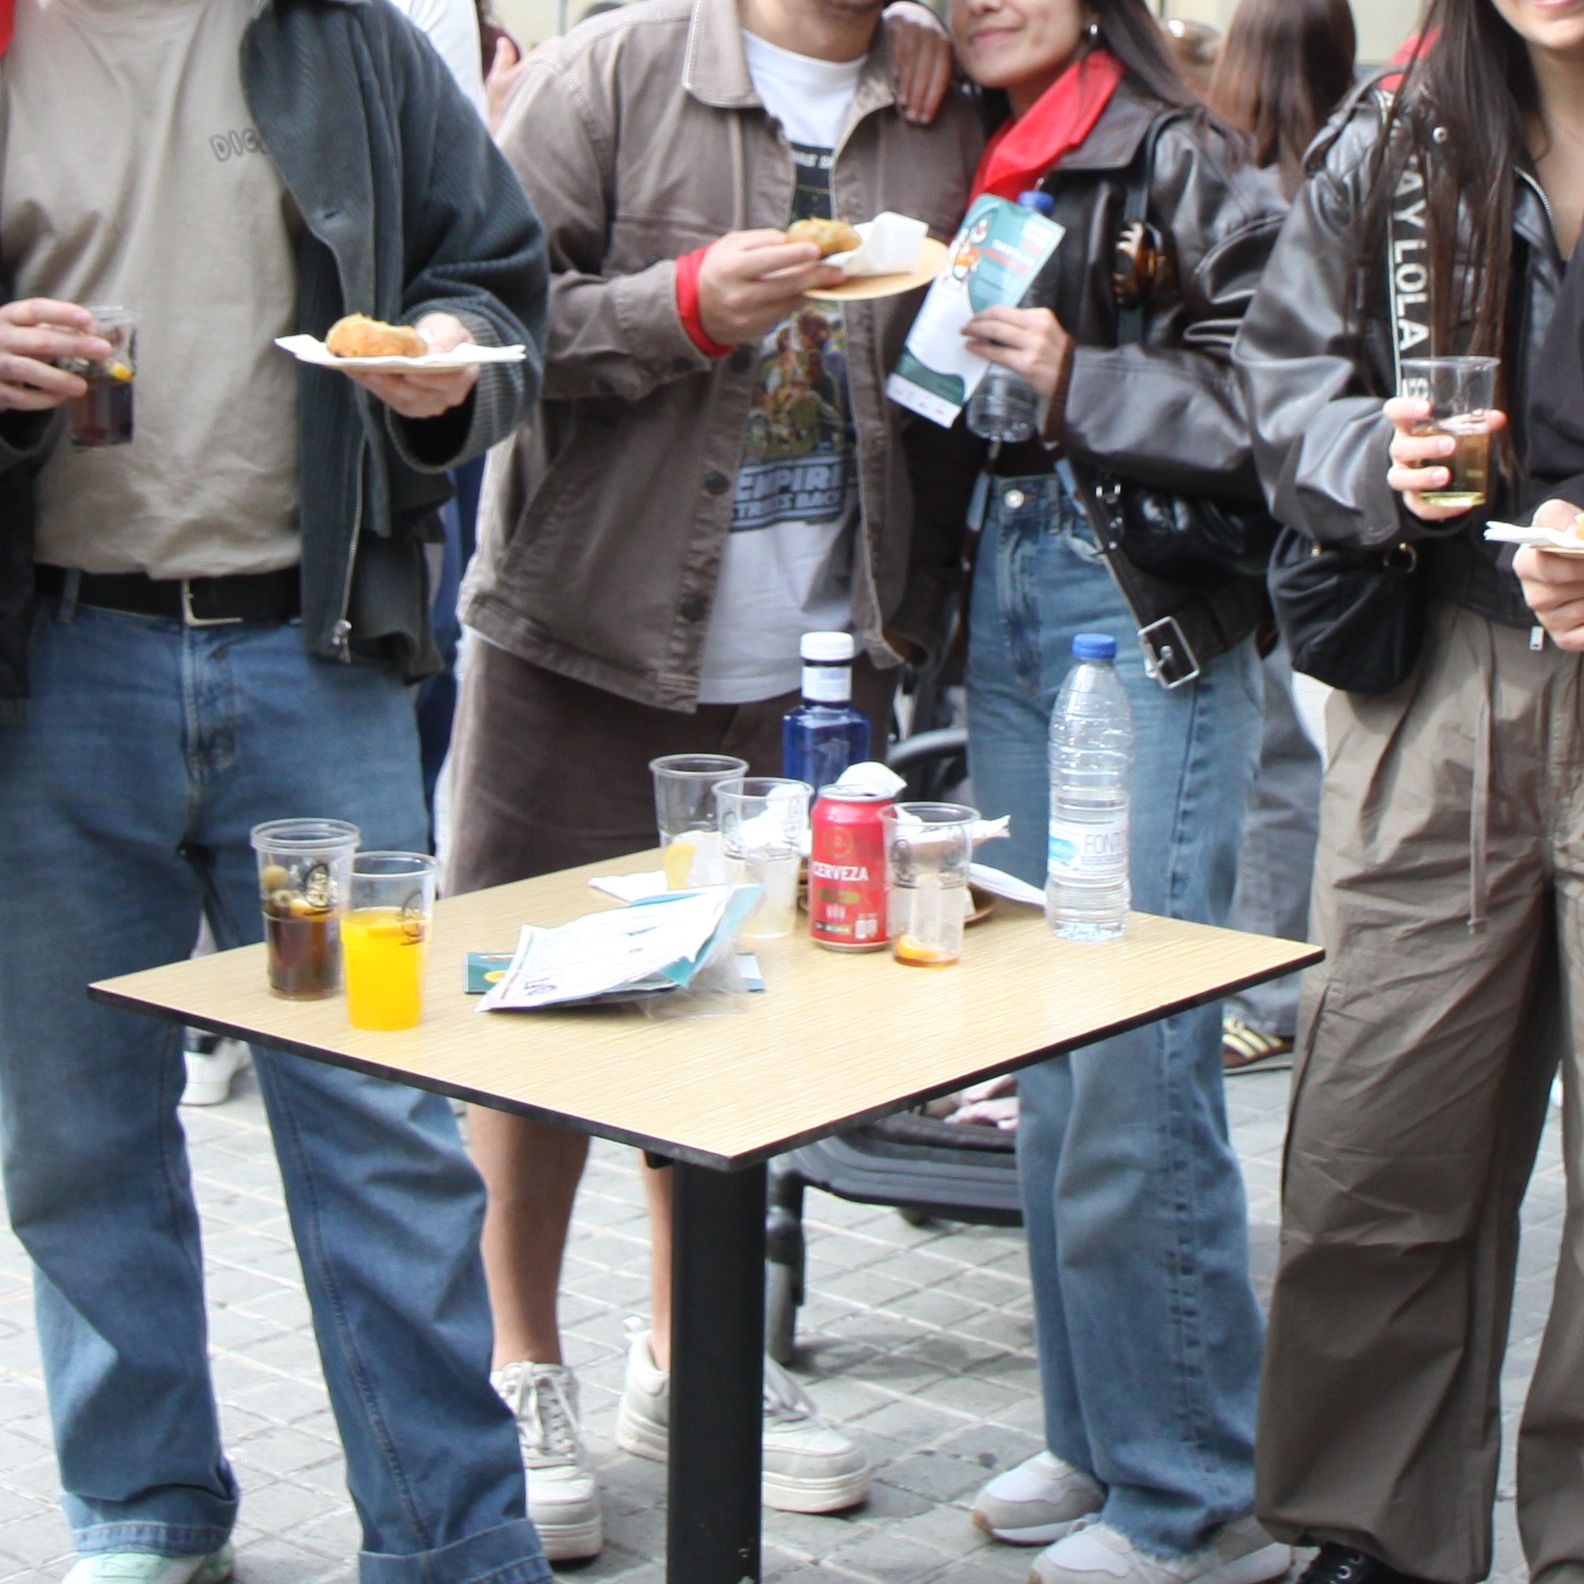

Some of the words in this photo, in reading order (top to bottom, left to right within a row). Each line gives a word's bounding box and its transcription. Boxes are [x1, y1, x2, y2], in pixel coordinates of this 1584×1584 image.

[209, 129, 268, 162] DIC
[1394, 239, 1430, 352] LOLA
[813, 861, 870, 882] CERVEZA
